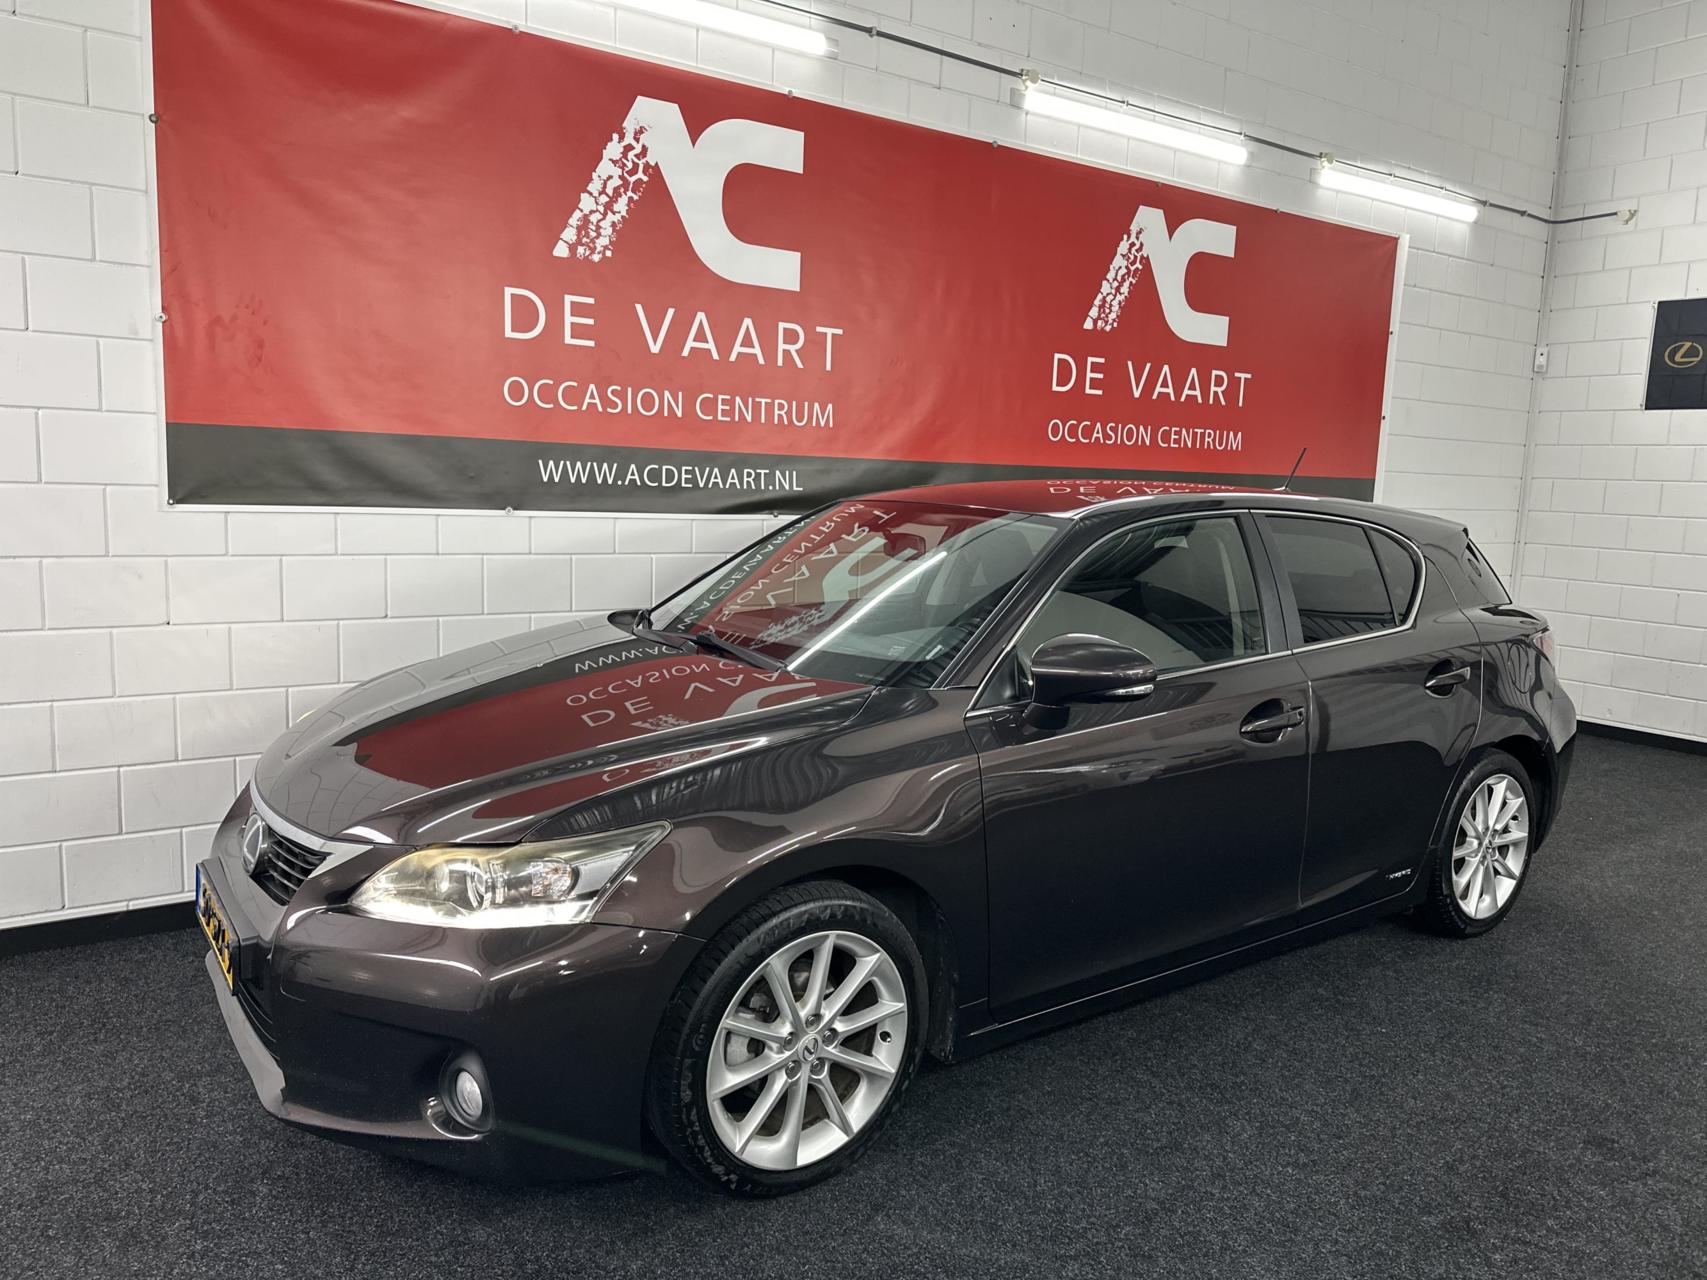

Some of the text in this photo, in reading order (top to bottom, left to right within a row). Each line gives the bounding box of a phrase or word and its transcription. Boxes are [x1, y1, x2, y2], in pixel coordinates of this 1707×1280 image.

[552, 95, 804, 292] AC
[1083, 205, 1237, 347] AC
[503, 286, 844, 372] DE VAART
[503, 376, 834, 428] OCCASION CENTRUM
[1051, 353, 1252, 407] DE VAART
[1048, 419, 1242, 451] OCCASION CENTRUM
[538, 459, 803, 491] WWW.ACDEVAART.NL
